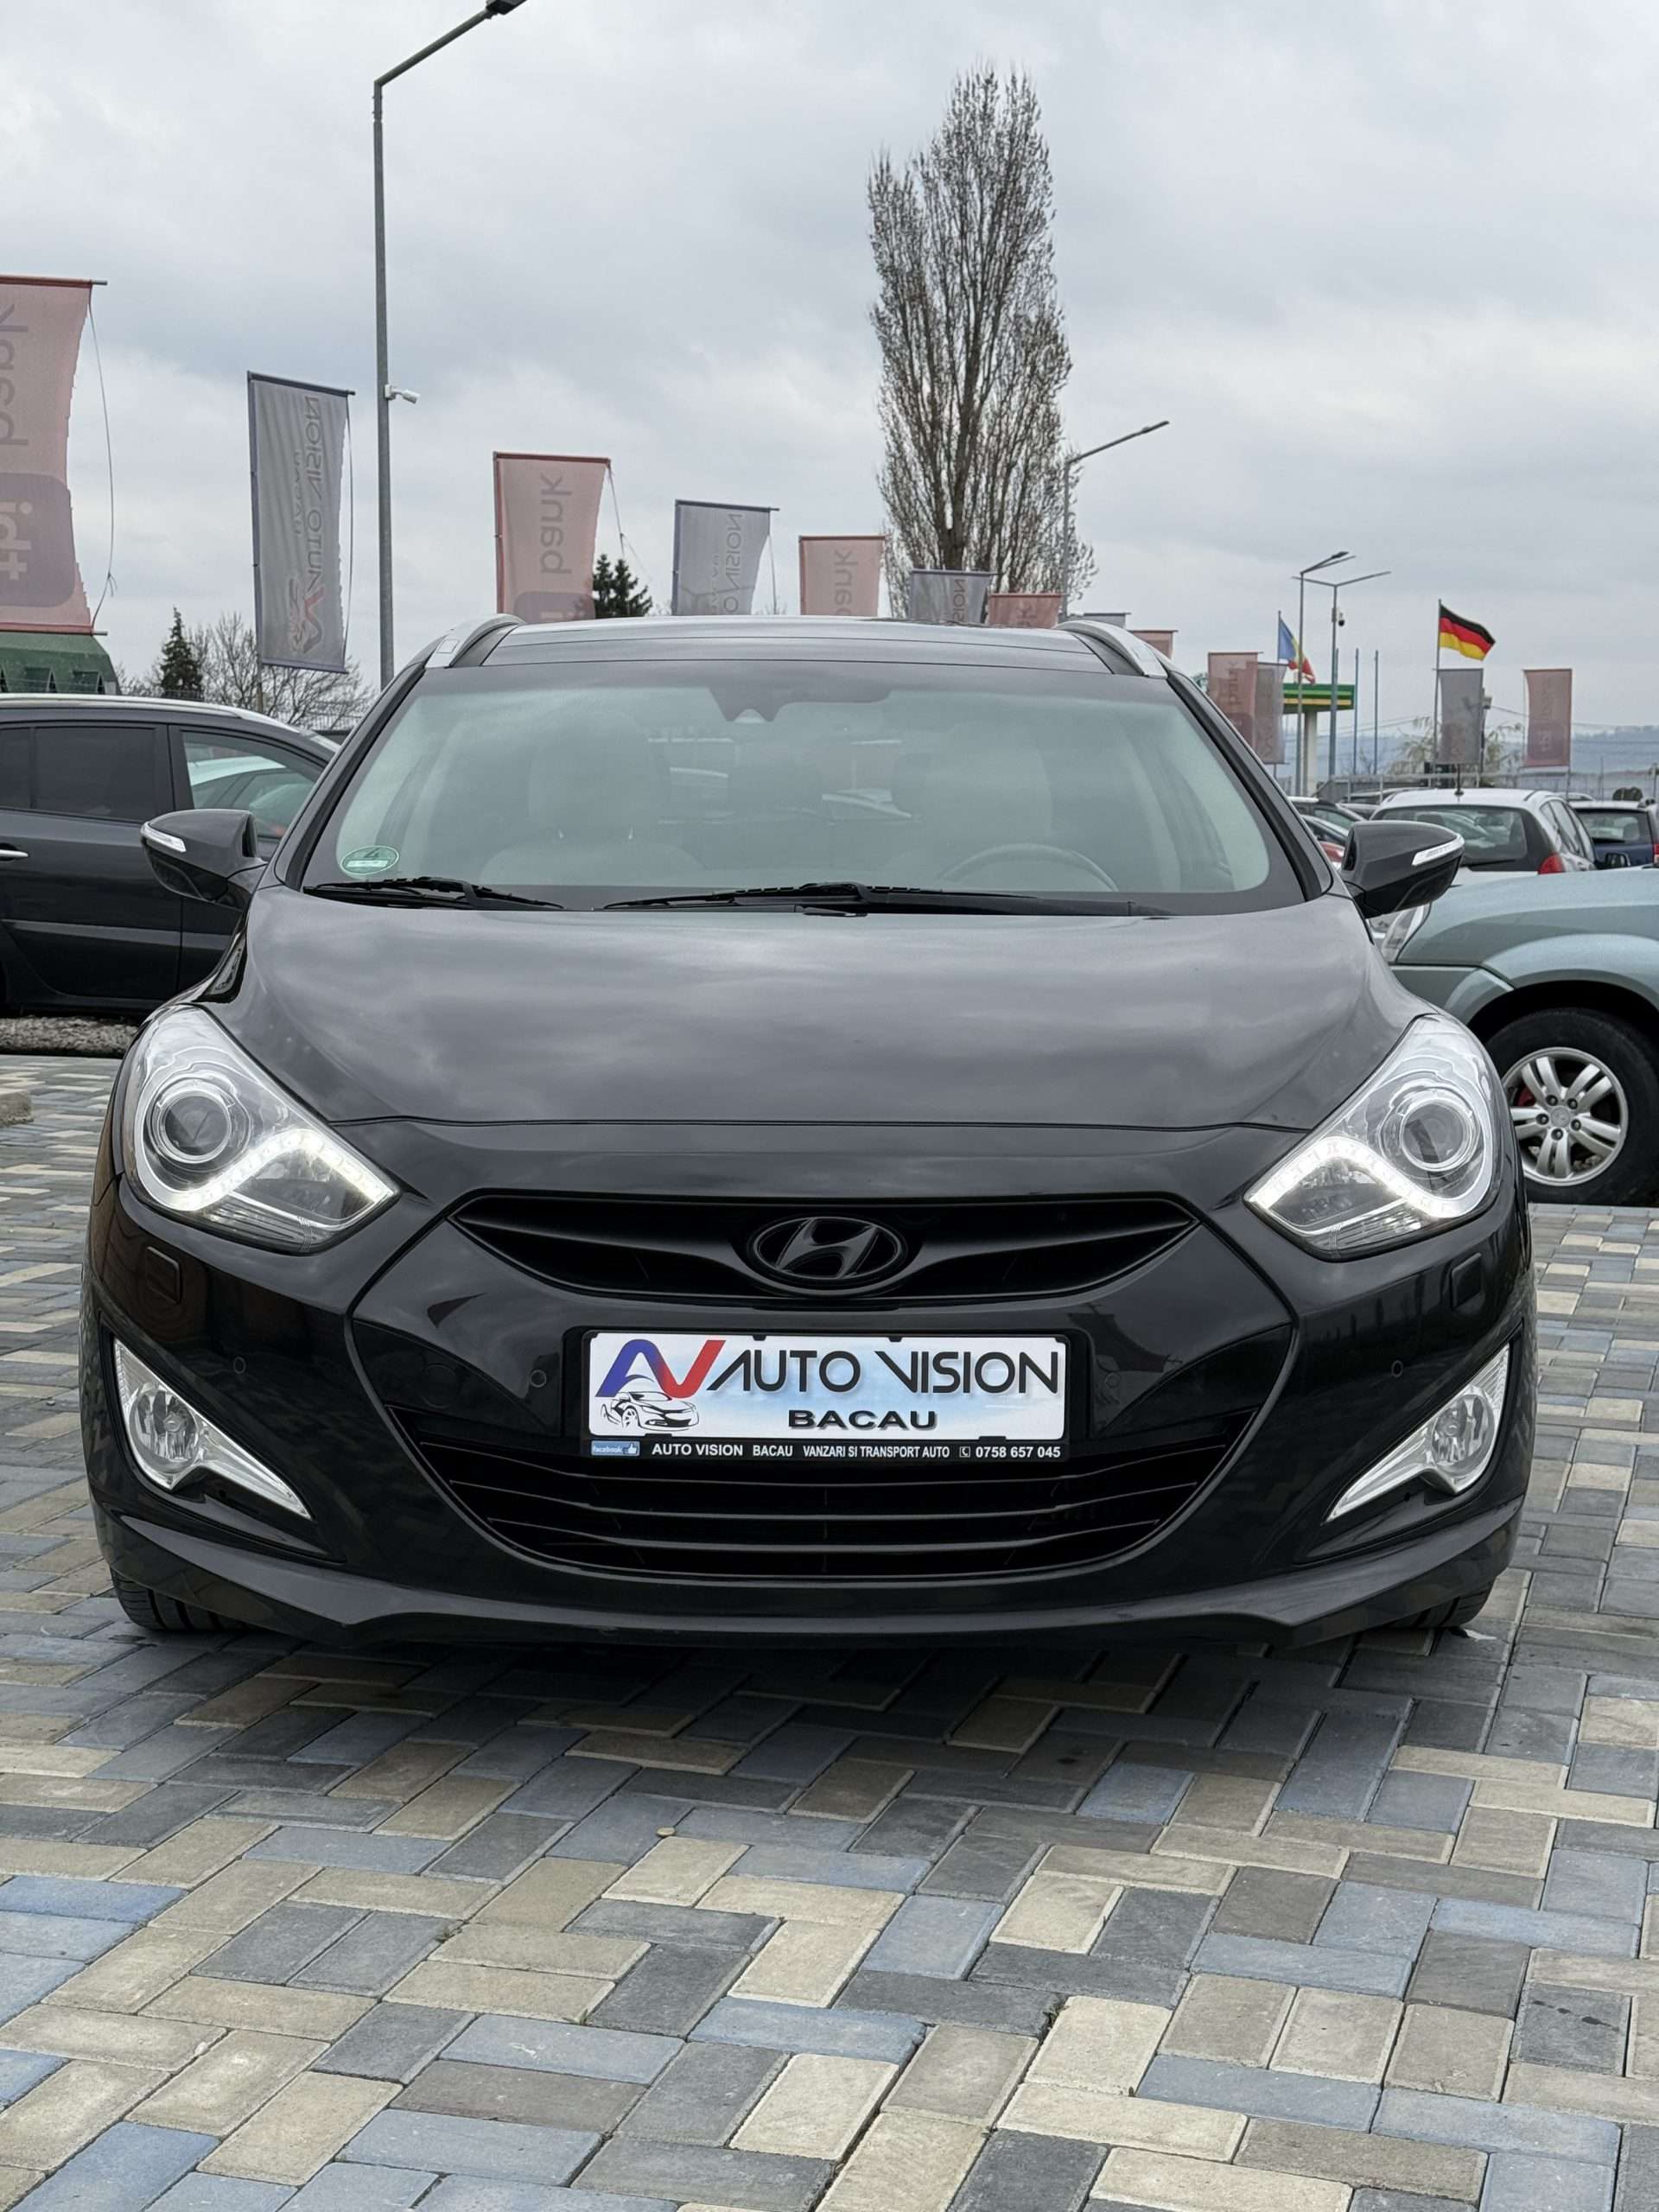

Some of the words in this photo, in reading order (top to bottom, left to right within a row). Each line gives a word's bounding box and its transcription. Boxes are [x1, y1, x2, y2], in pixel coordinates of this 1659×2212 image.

[707, 1350, 861, 1393] AUTO
[874, 1351, 1058, 1394] VISION
[788, 1409, 937, 1429] BACAU
[652, 1444, 692, 1456] AUTO
[696, 1444, 744, 1456] VISION
[753, 1445, 793, 1457] BACAU
[803, 1445, 845, 1458] VANZARI
[848, 1446, 858, 1458] SI
[860, 1446, 921, 1458] TRANSPORT
[922, 1446, 950, 1459] AUTO
[976, 1446, 1007, 1459] 0758
[1010, 1446, 1033, 1459] 657
[1037, 1446, 1061, 1459] 045
